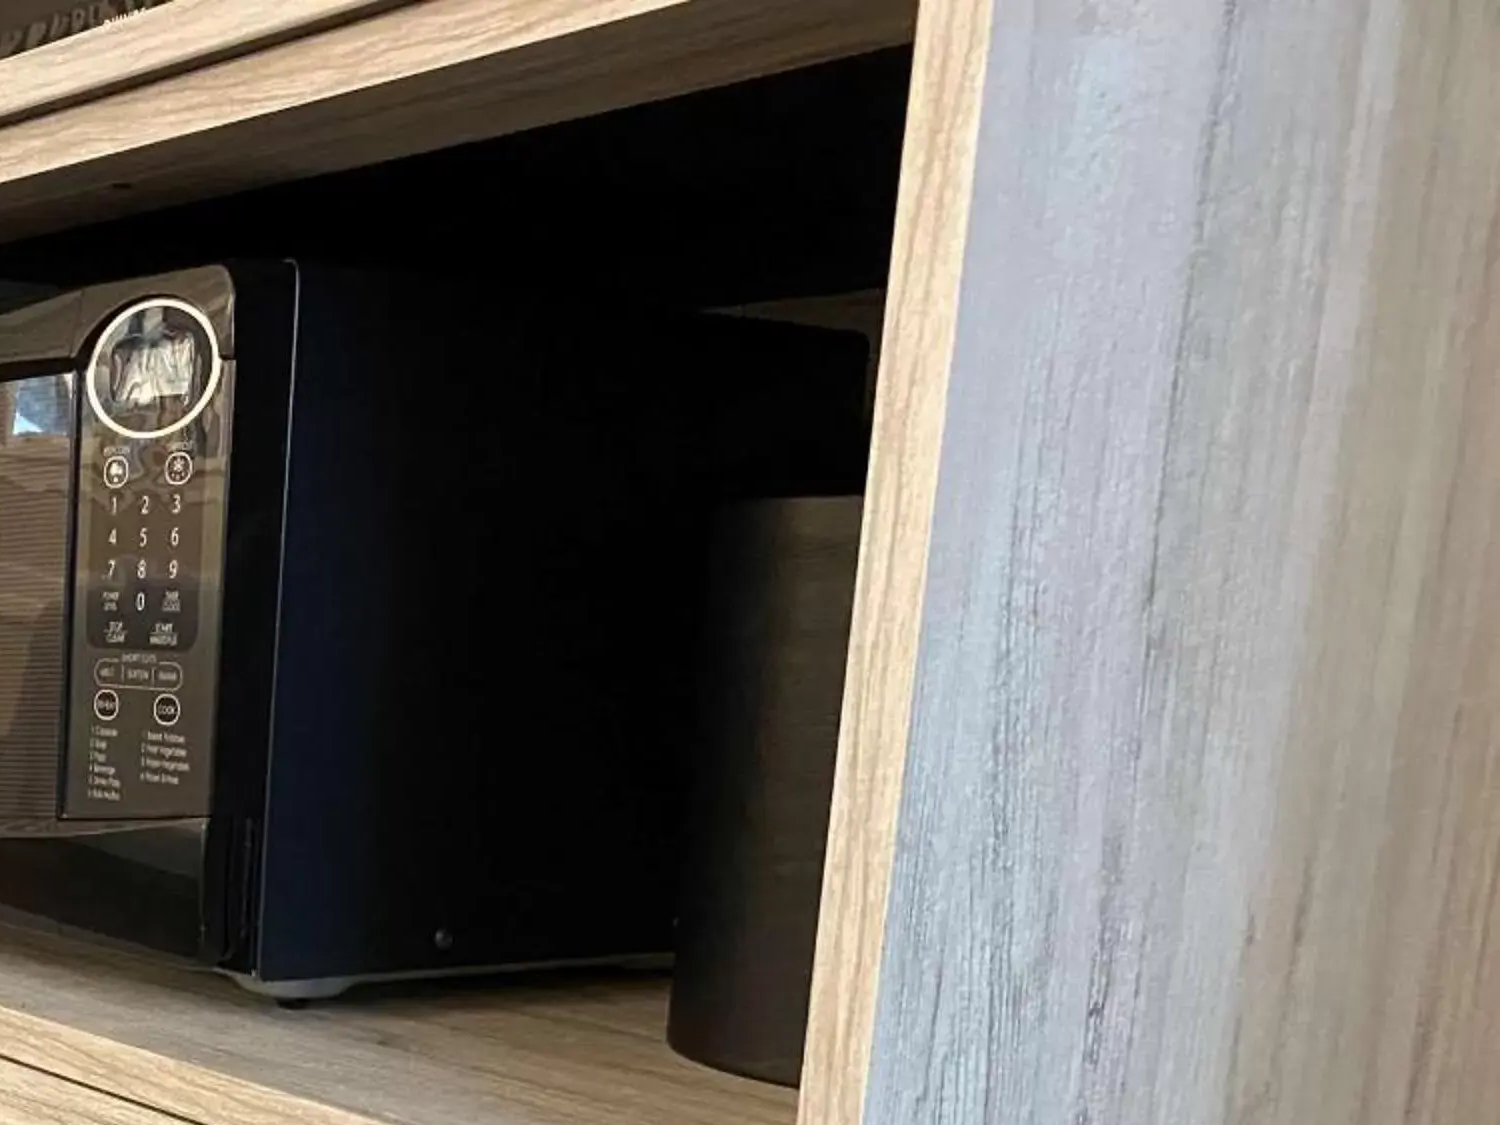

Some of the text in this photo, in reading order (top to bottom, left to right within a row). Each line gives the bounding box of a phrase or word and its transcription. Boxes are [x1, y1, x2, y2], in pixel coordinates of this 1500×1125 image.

[111, 494, 181, 514] 1 2 3
[108, 527, 179, 547] 4 5 6
[107, 559, 178, 579] 7 8 9
[136, 592, 145, 611] 0
